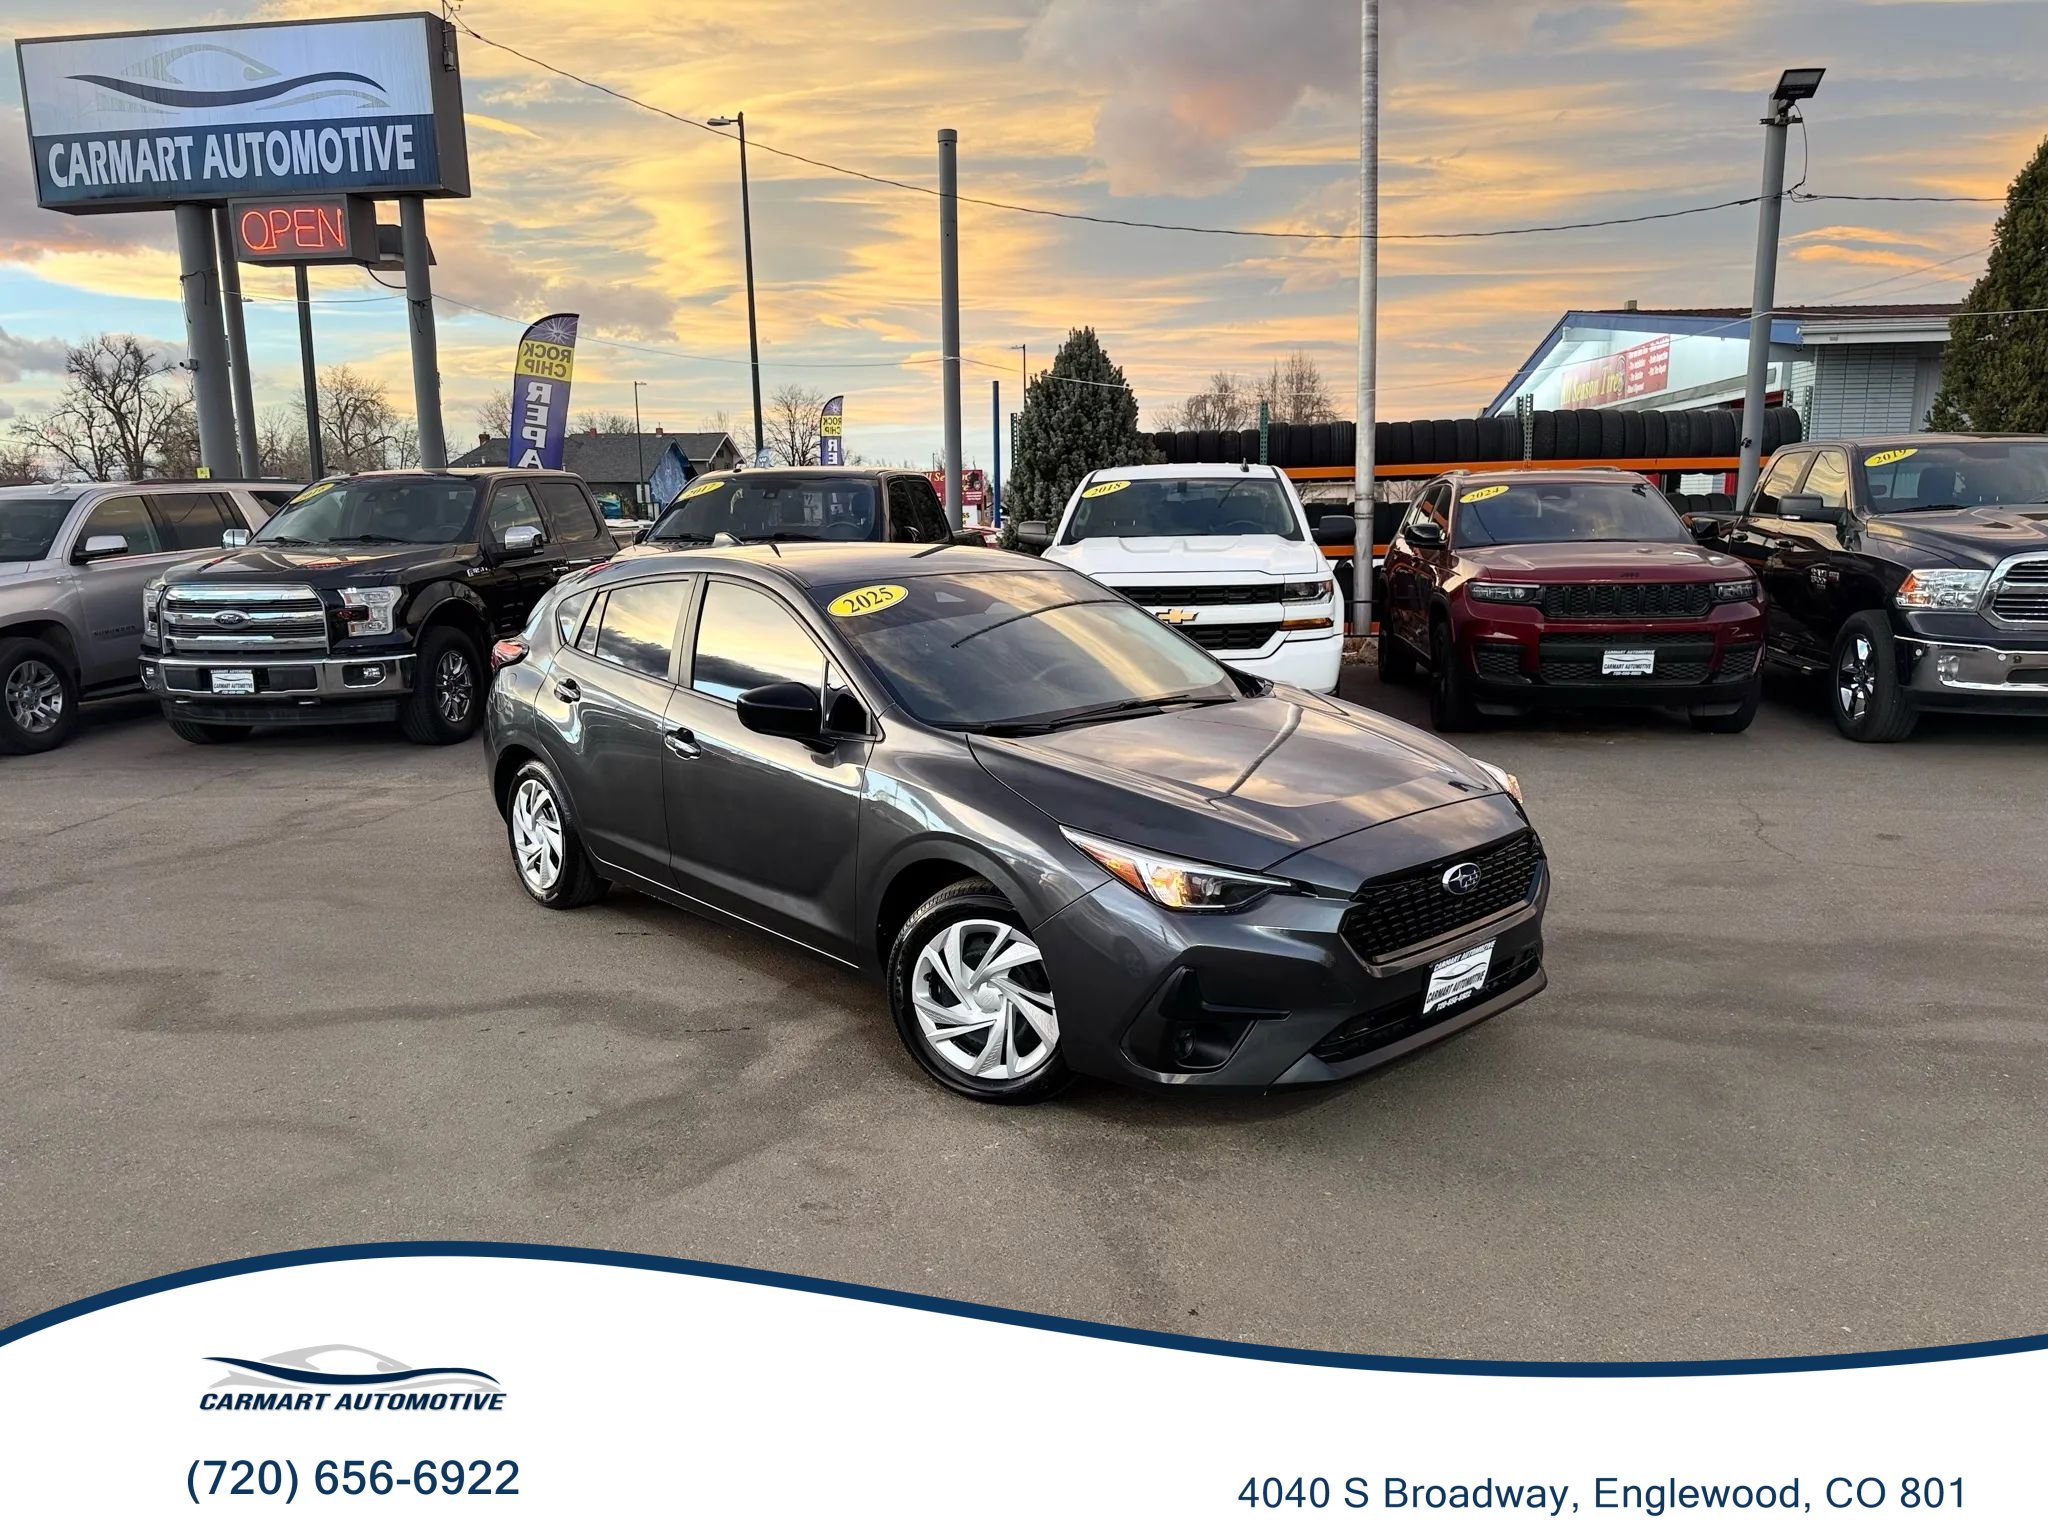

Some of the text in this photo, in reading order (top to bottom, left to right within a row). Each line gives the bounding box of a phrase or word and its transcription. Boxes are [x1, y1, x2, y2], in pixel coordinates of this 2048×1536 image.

[48, 125, 415, 188] CARMART AUTOMOTIVE
[241, 207, 346, 251] OPEN
[1874, 449, 1906, 464] 2019
[1091, 482, 1122, 496] 2018
[1469, 487, 1499, 501] 2024
[843, 587, 894, 613] 2025
[1426, 970, 1486, 1004] CARMART AUTOMOTIVE
